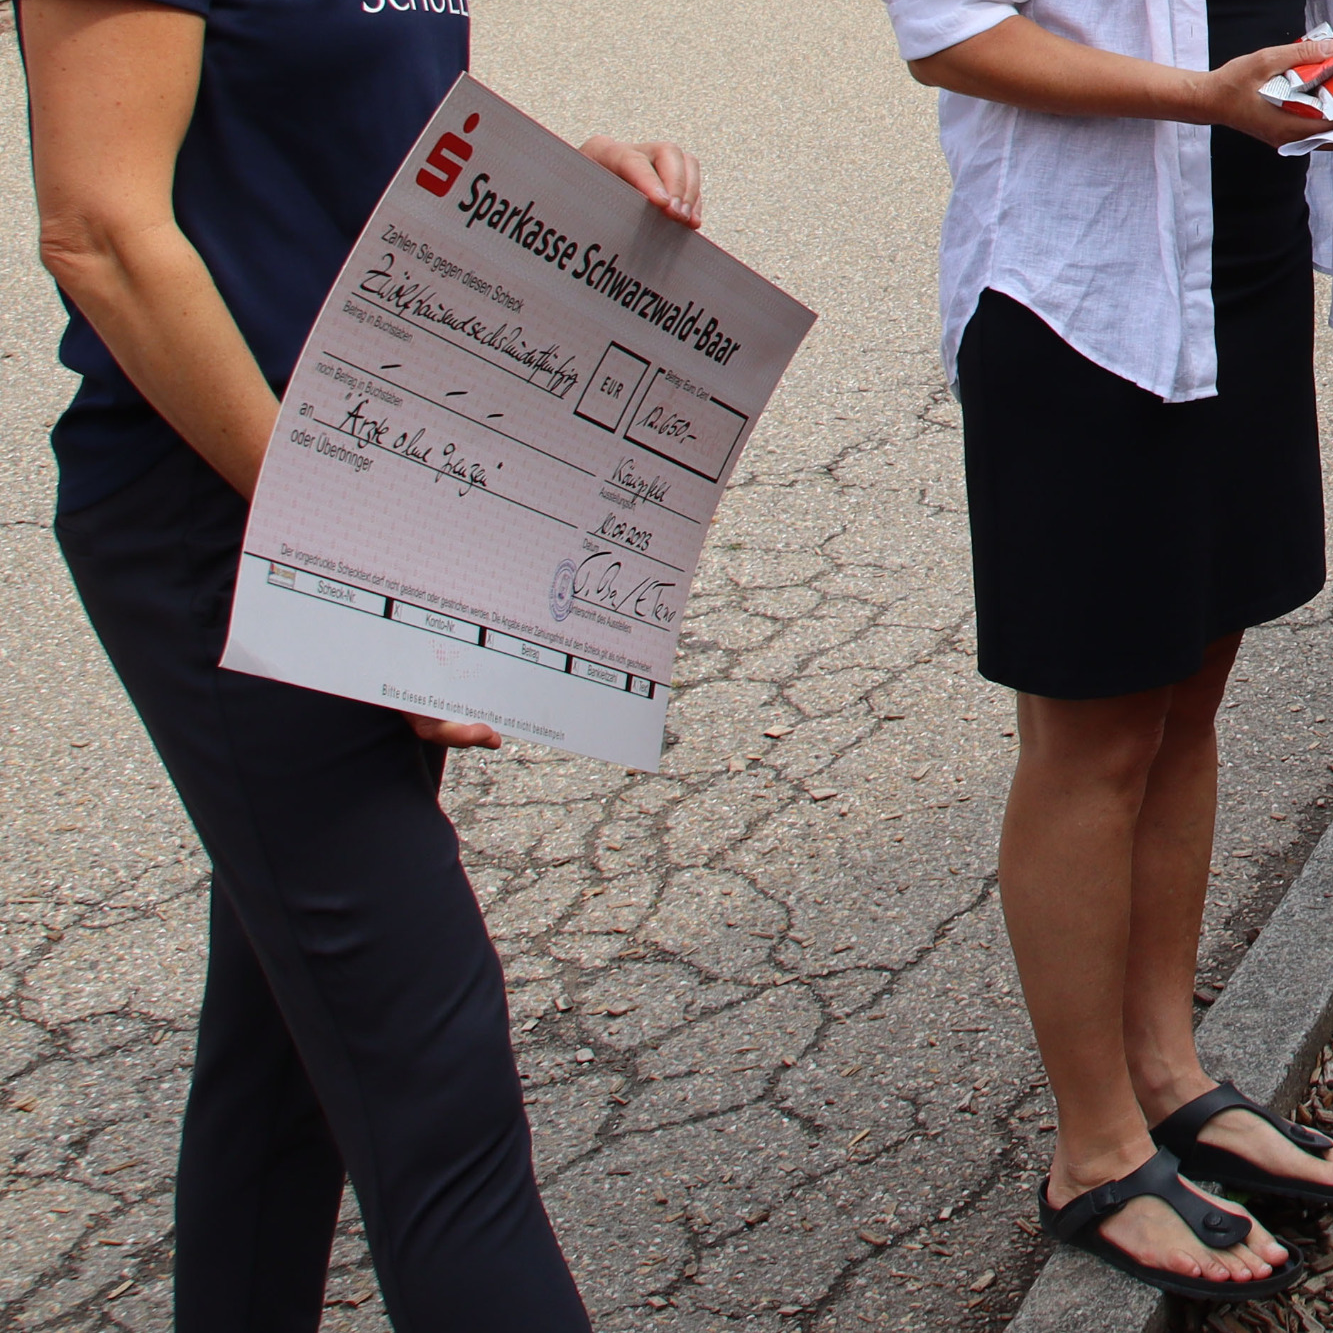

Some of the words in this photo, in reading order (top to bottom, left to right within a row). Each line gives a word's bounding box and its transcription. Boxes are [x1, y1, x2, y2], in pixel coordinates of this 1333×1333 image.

[380, 223, 417, 254] Zahlen
[415, 242, 434, 264] Sie
[429, 255, 463, 279] gegen
[461, 270, 493, 296] diesen
[490, 284, 524, 313] Scheck
[457, 172, 578, 270] Sparkasse
[571, 242, 741, 366] Schwarzwald-Baar
[342, 299, 367, 323] Betrag
[365, 314, 375, 324] in
[372, 314, 413, 341] Buchstaben
[317, 361, 335, 376] noch
[333, 366, 358, 390] Betrag
[356, 380, 365, 390] in
[363, 380, 403, 406] Buchstaben
[599, 375, 624, 398] EUR
[695, 386, 710, 401] Cent
[298, 401, 314, 417] an
[290, 428, 316, 447] oder
[315, 431, 374, 472] Überbringer
[581, 537, 599, 555] Datum
[520, 643, 539, 662] Betrag
